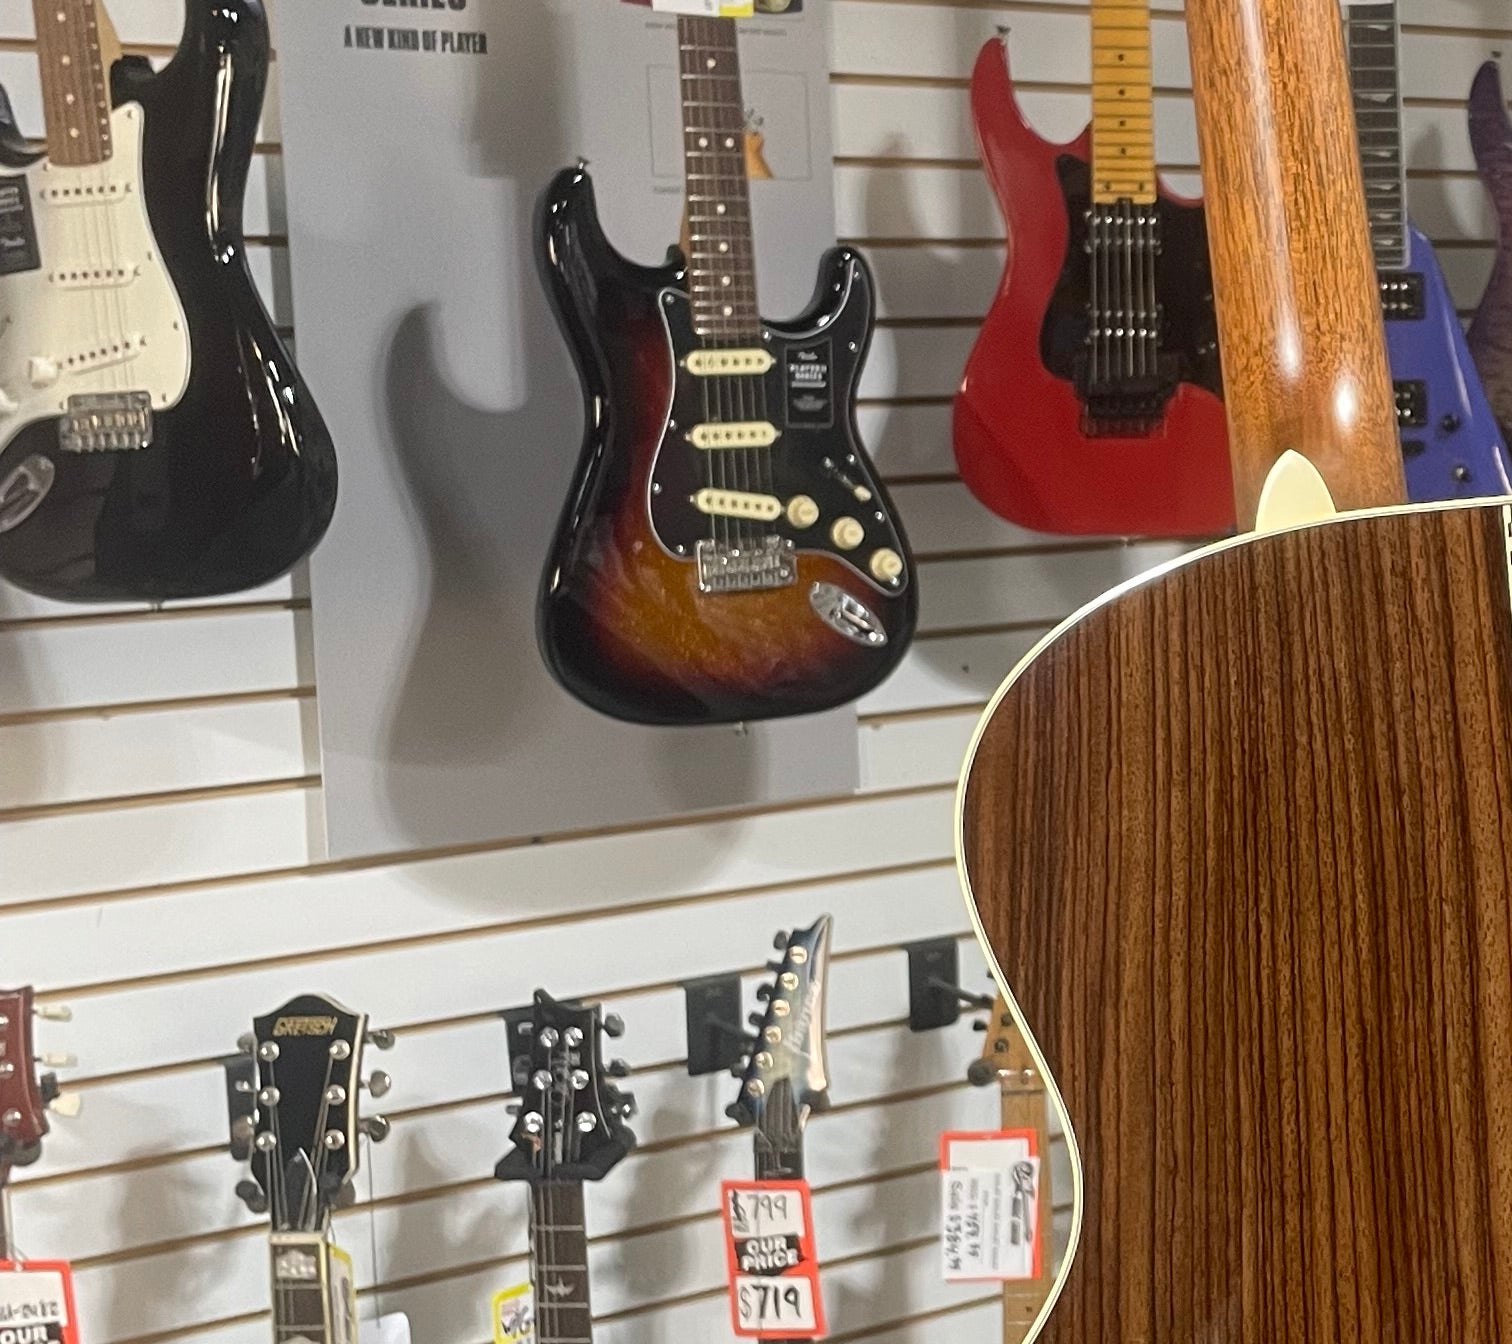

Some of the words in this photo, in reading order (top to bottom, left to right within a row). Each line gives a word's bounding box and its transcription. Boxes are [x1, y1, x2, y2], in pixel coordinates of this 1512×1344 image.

[343, 24, 353, 48] A
[354, 25, 385, 50] NEW
[387, 27, 420, 52] KIND
[422, 29, 438, 53] OF
[441, 30, 488, 55] PLAYER
[741, 1247, 801, 1272] PRICE
[746, 1235, 788, 1258] OUR
[740, 1284, 802, 1321] $719
